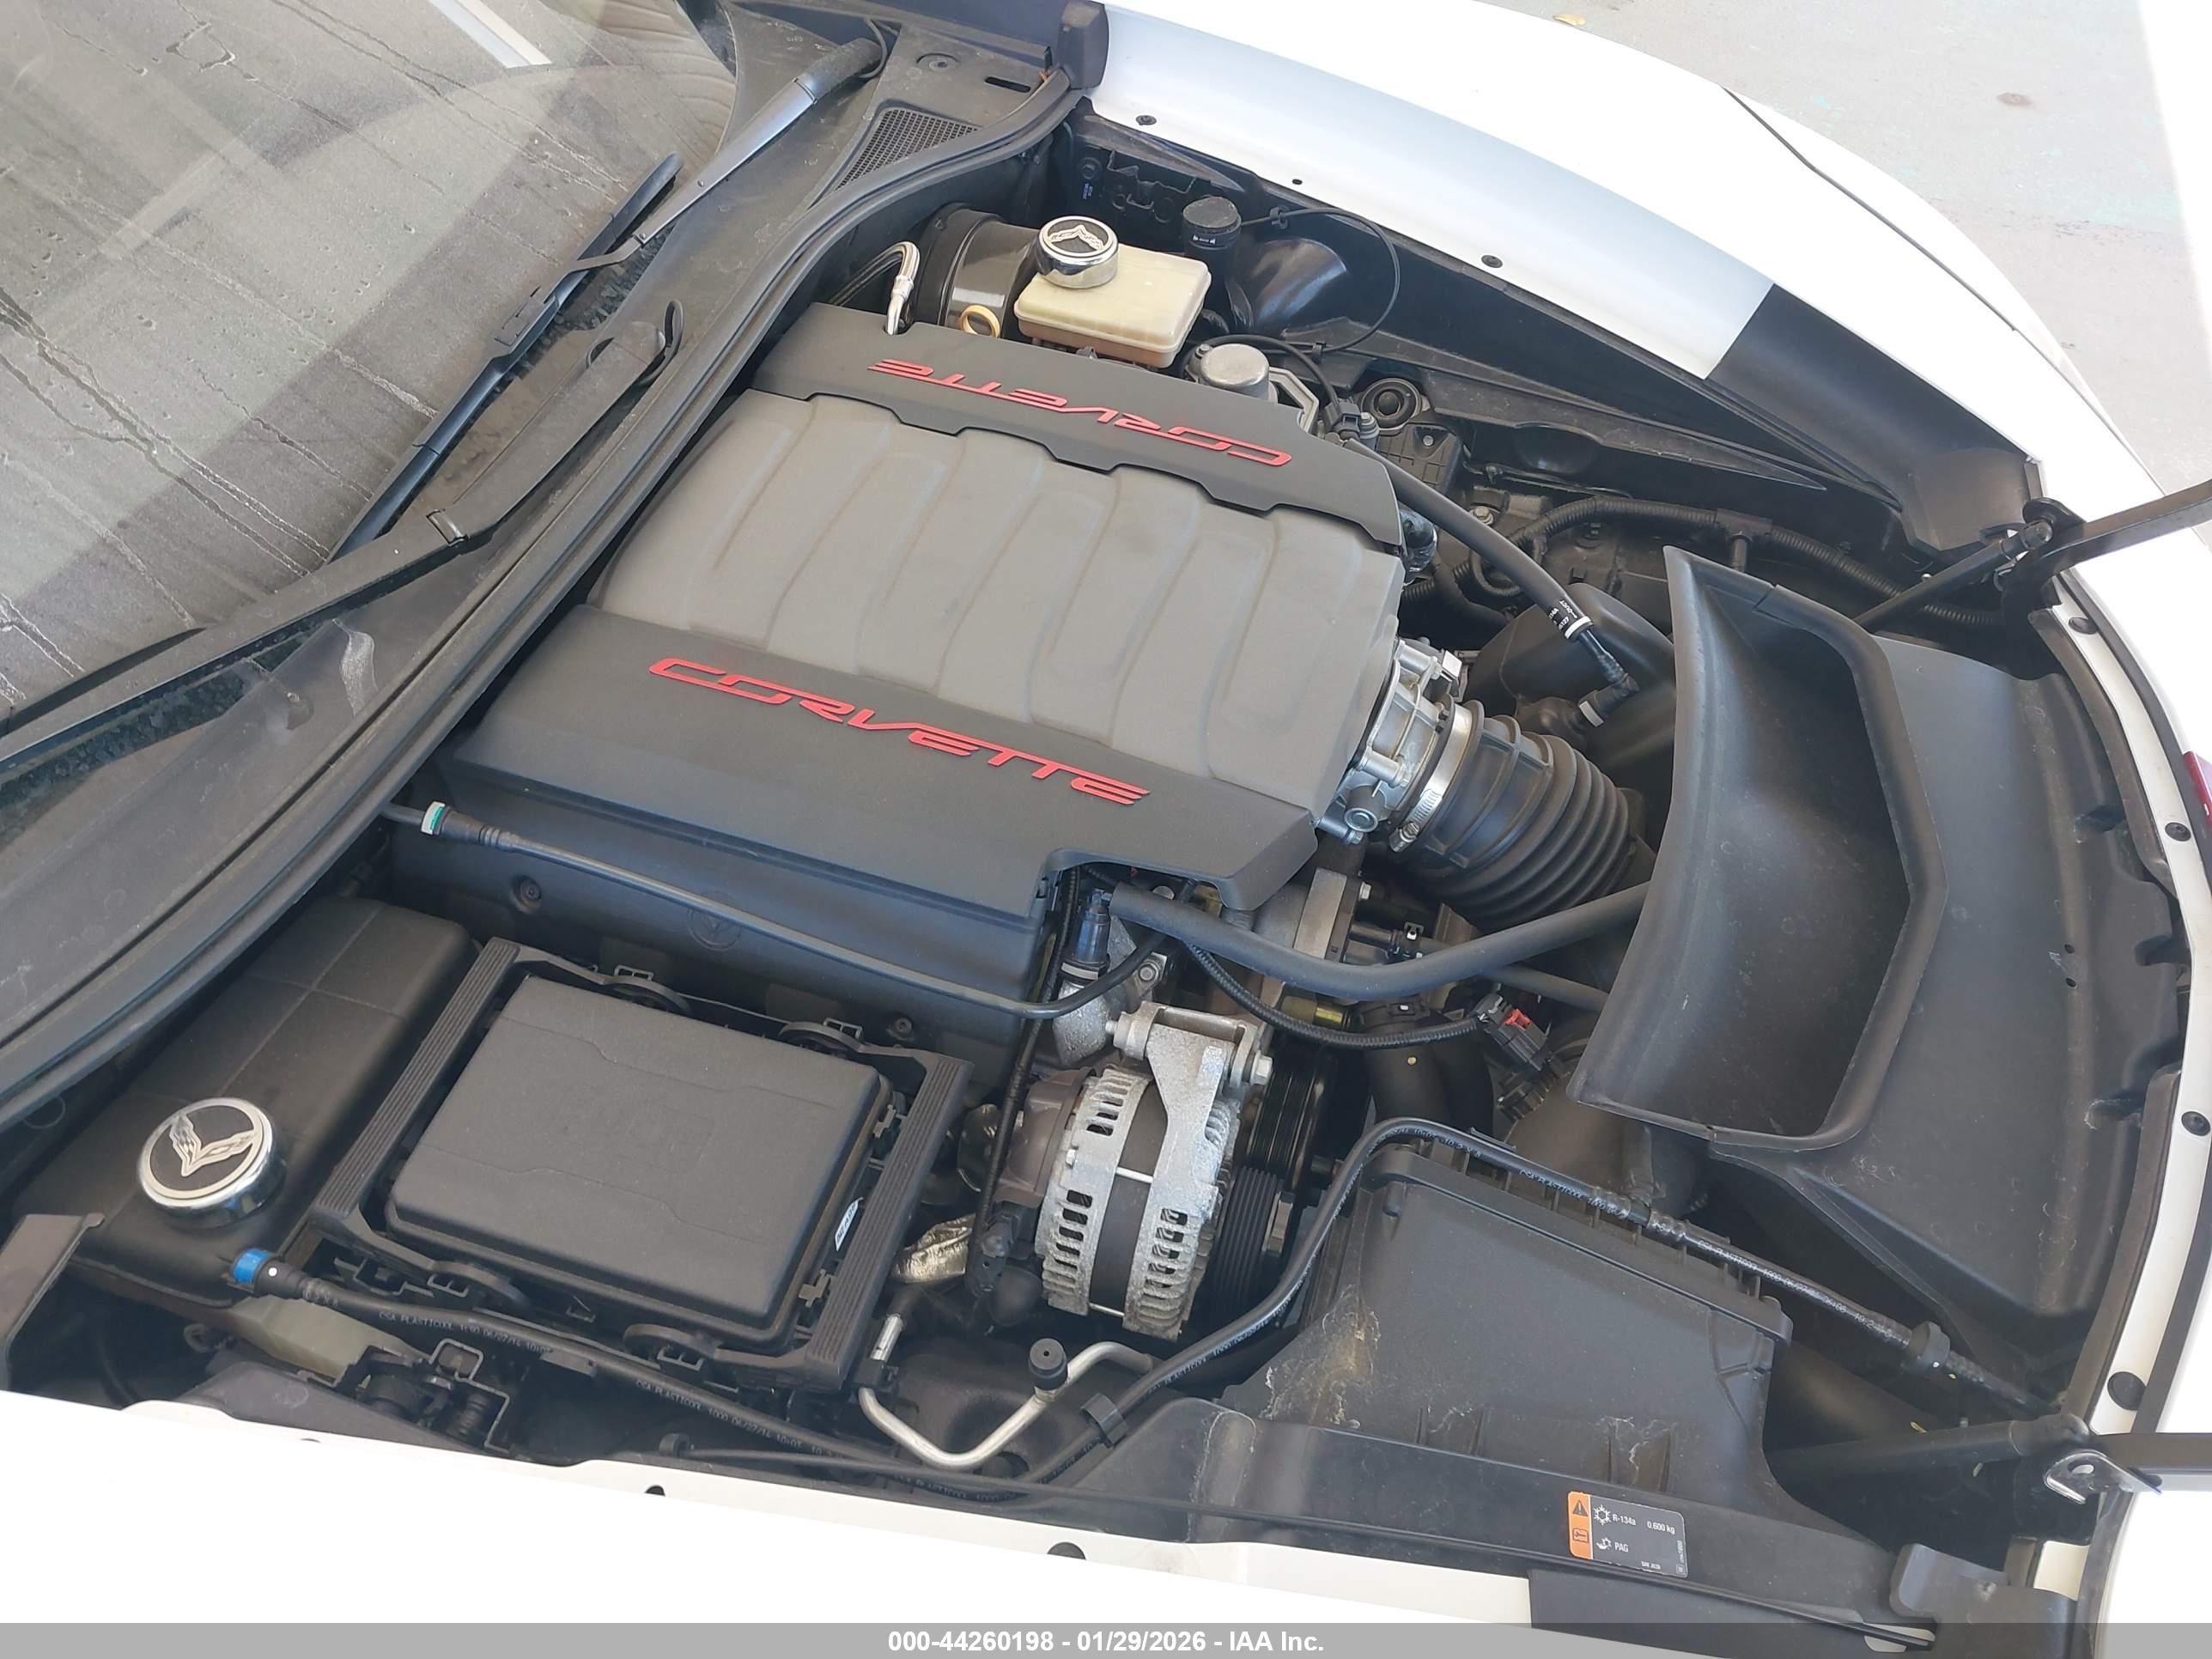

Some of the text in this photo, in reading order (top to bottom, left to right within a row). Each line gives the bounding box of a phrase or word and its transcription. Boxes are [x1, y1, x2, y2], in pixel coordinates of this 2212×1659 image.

[867, 359, 1291, 466] CORVETTE
[649, 658, 1151, 805] CORVETTE
[1613, 1513, 1636, 1526] R-134a
[1666, 1524, 1675, 1535] kg
[1614, 1541, 1629, 1553] PAG
